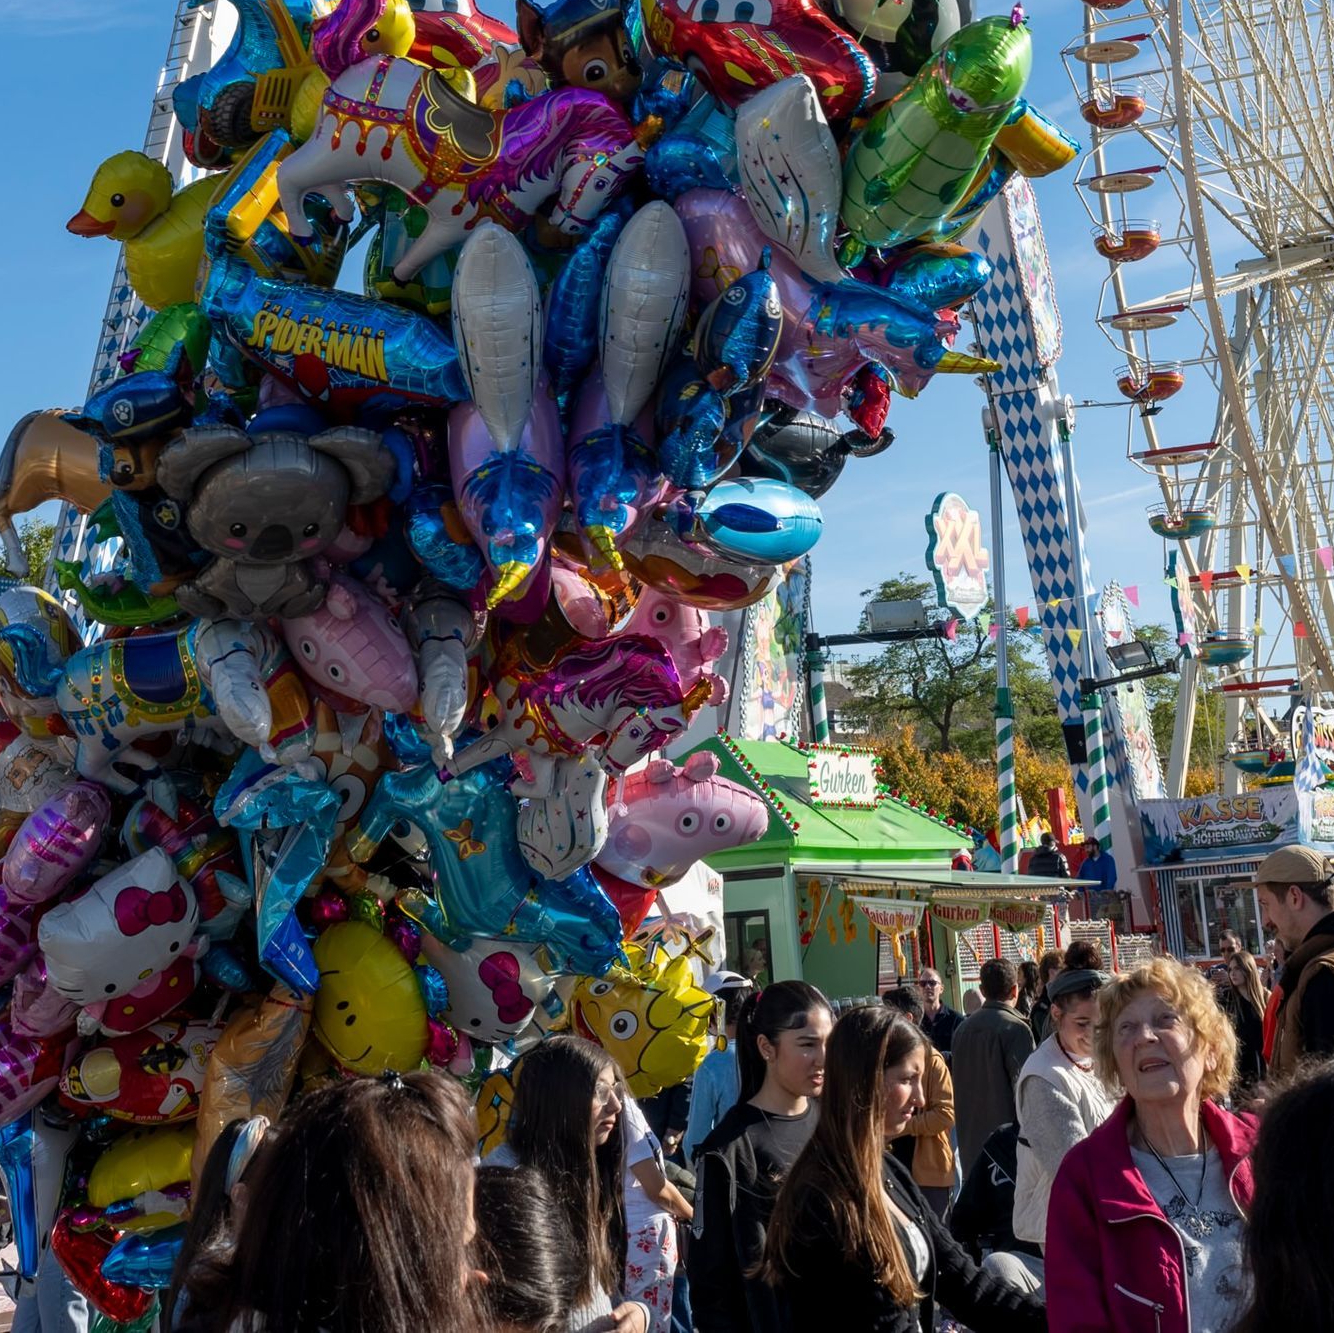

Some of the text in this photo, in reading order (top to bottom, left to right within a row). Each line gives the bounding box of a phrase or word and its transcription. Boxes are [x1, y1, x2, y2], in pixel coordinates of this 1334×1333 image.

[264, 300, 387, 340] THE AMAZING
[247, 309, 390, 384] SPIDER-MAN
[935, 514, 989, 577] XXL
[820, 761, 868, 794] Gurken
[1178, 797, 1263, 829] KASSE
[1192, 826, 1267, 845] HÖHENRAUSCH
[933, 904, 980, 921] Gurken
